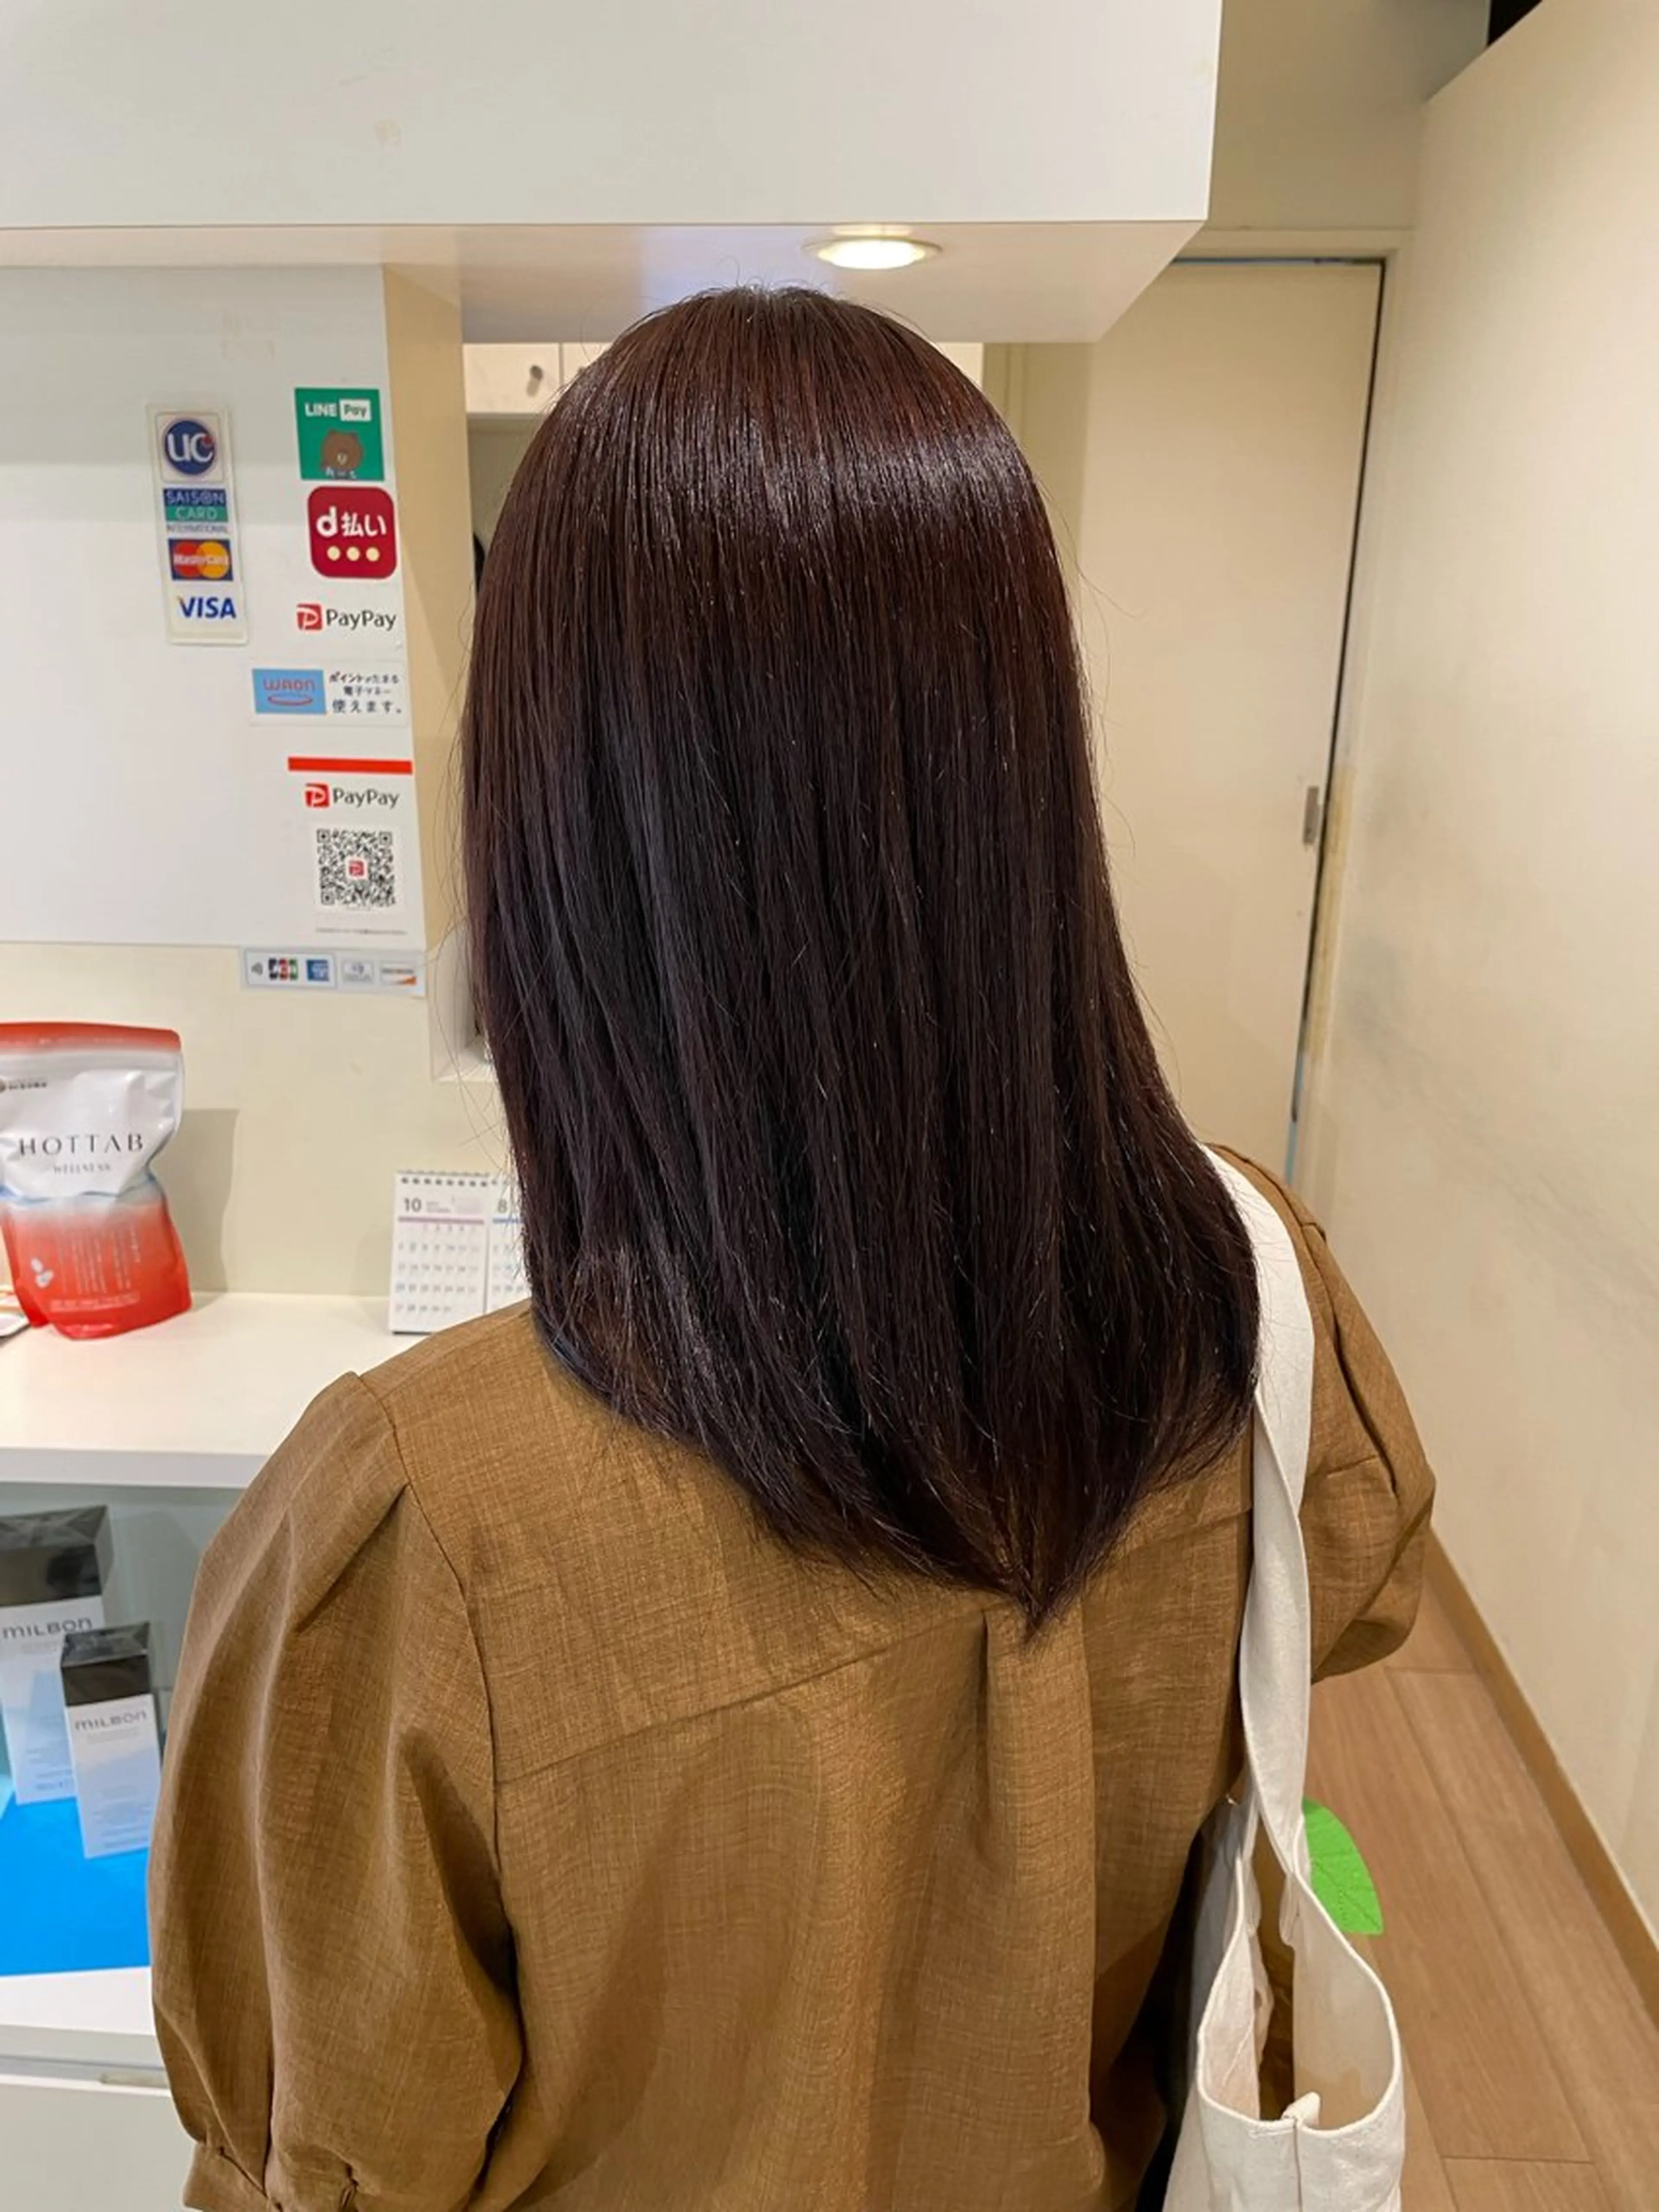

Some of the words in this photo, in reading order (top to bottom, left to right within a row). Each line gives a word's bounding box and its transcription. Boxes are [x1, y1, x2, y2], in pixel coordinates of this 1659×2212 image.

[305, 403, 337, 417] LINE
[343, 404, 367, 419] Pay
[166, 433, 214, 463] UC
[166, 489, 224, 505] SAISON
[175, 505, 217, 520] CARD
[316, 506, 386, 538] d払い
[178, 596, 237, 619] VISA
[326, 609, 397, 630] PayPay
[332, 787, 400, 810] PayPay
[19, 1131, 143, 1156] HOTTAB
[404, 1197, 422, 1213] 10
